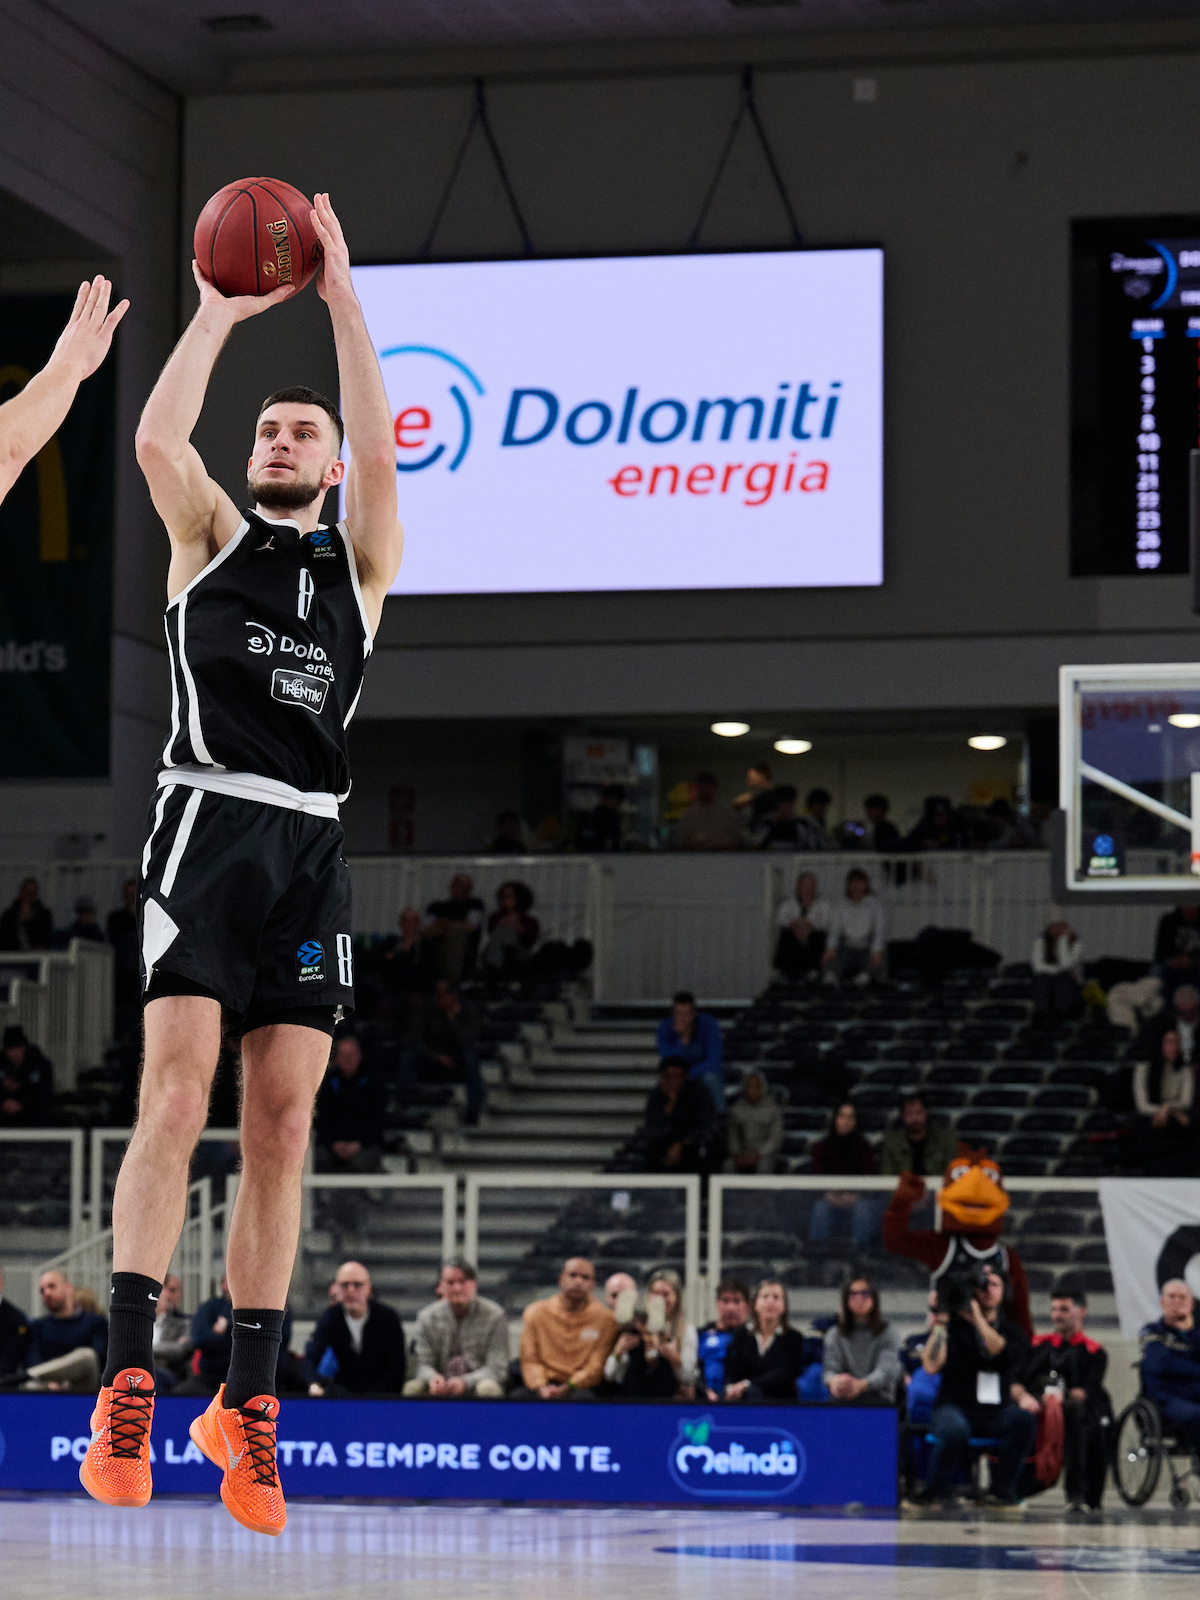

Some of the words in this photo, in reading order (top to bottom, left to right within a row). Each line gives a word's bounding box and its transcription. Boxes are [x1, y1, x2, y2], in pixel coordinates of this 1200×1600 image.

[501, 382, 842, 446] Dolomiti
[608, 453, 830, 507] energia
[298, 567, 314, 621] 8
[280, 636, 327, 662] Dolo
[301, 966, 320, 975] BKT
[336, 933, 353, 988] 8
[299, 974, 324, 982] EuroCup
[345, 1442, 482, 1470] SEMPRE
[488, 1444, 561, 1471] CON
[569, 1446, 620, 1472] TE.
[675, 1441, 797, 1475] Melinda
